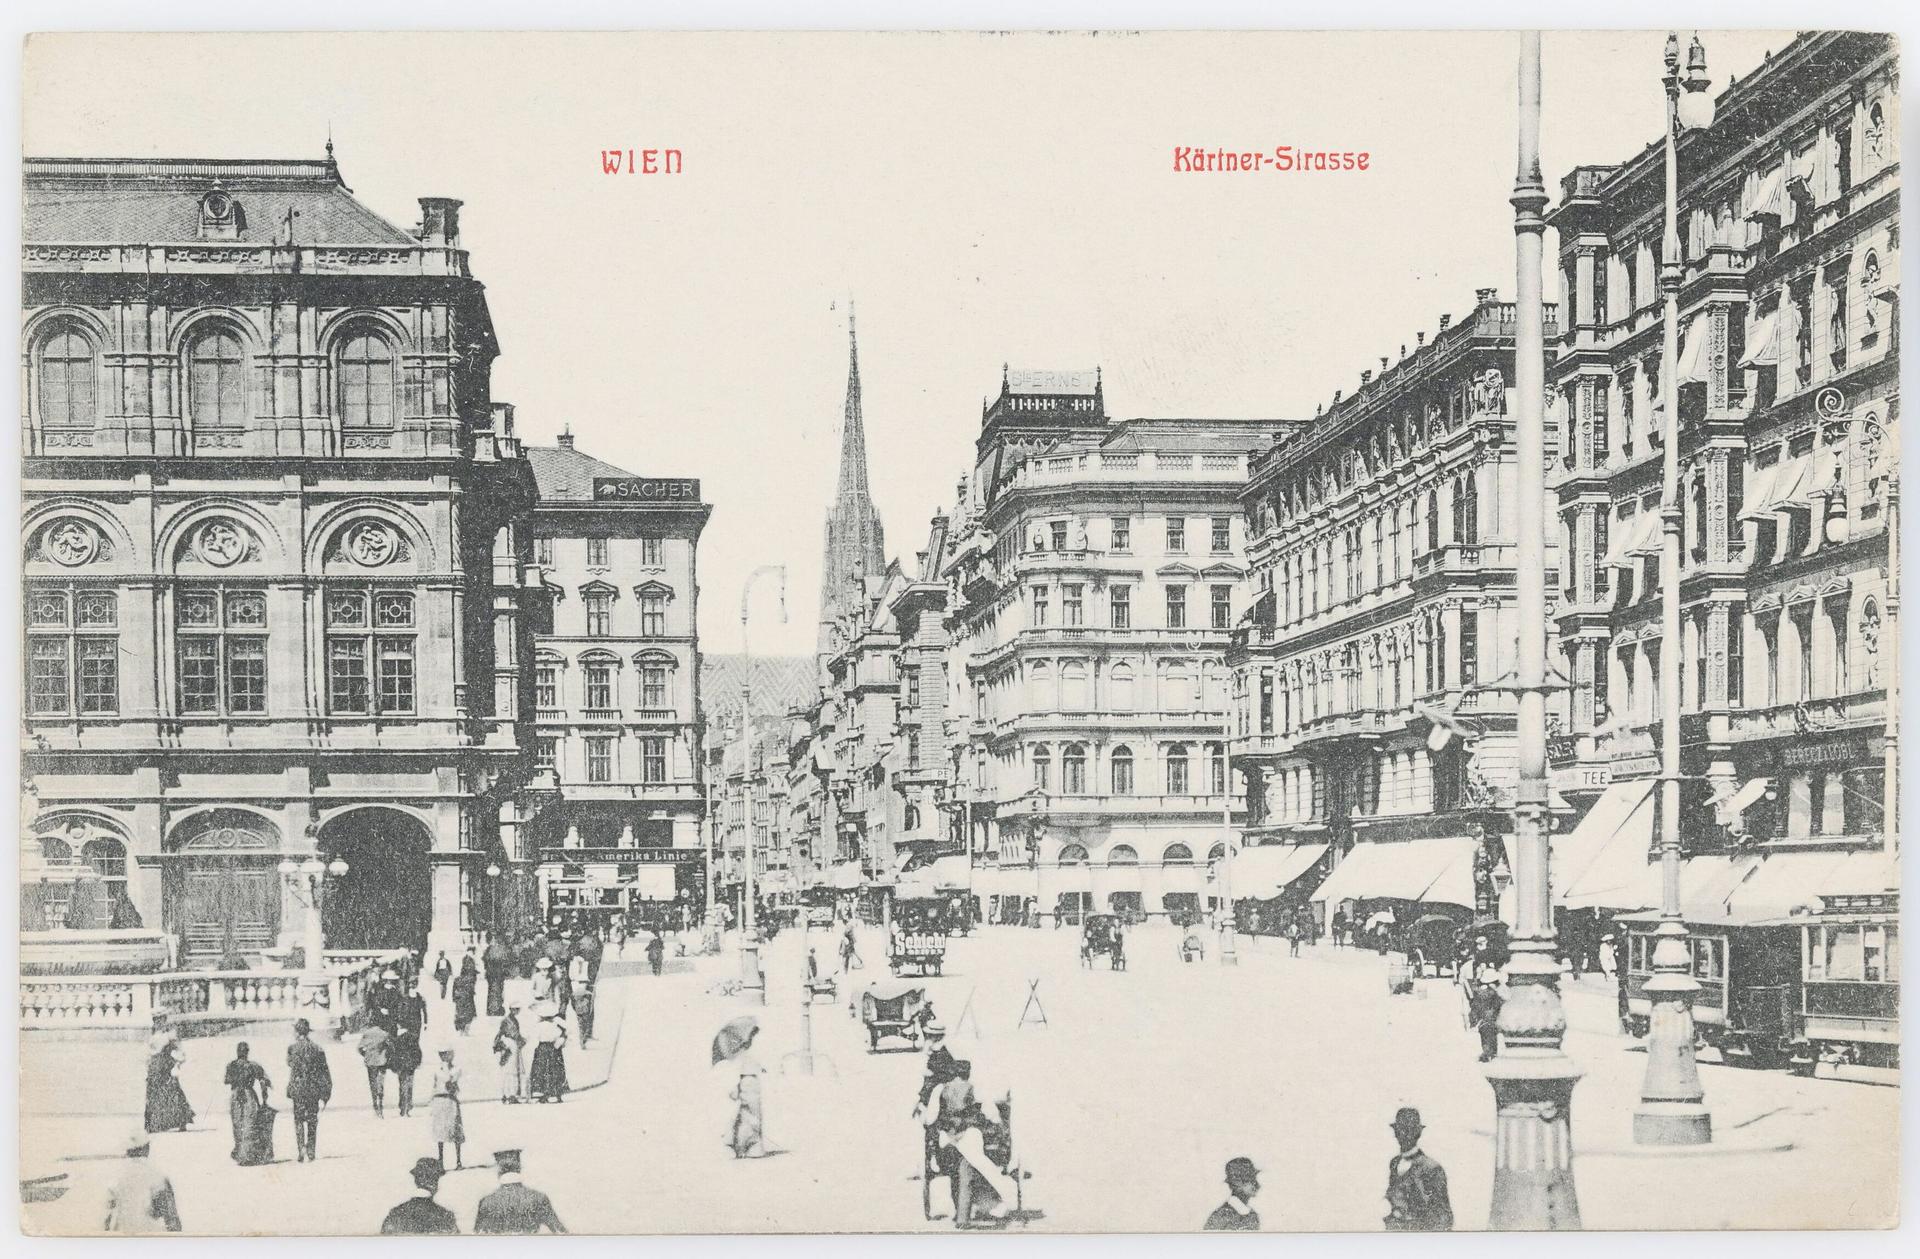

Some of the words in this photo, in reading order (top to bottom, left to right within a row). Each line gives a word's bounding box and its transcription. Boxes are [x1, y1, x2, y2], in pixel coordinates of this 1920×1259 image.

[618, 482, 694, 497] SACHER
[1583, 771, 1607, 785] TEE
[654, 850, 688, 861] Linie
